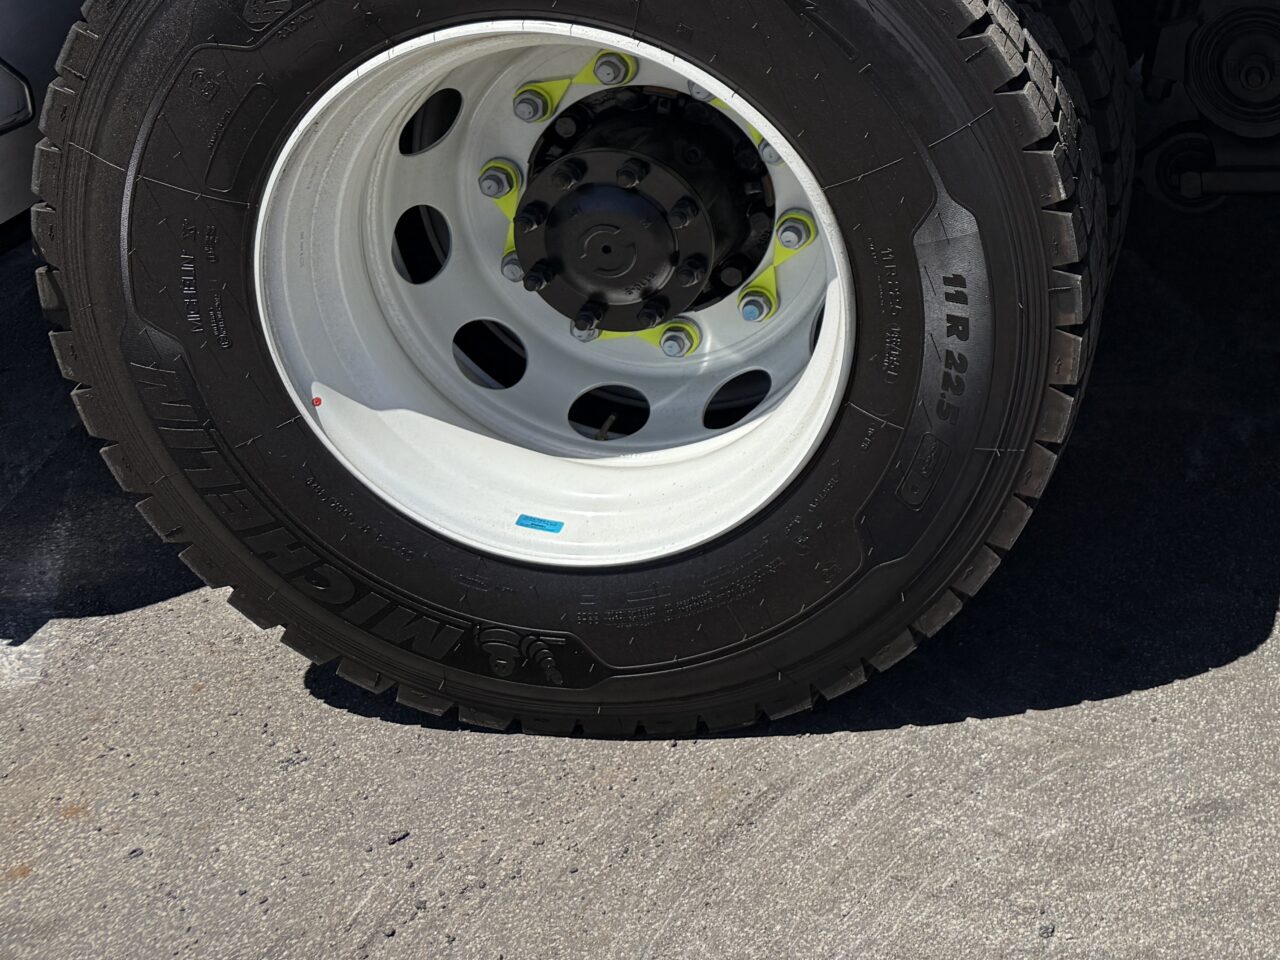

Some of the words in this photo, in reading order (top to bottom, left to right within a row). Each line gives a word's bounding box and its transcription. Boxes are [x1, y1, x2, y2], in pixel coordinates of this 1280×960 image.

[179, 253, 205, 334] MICHELIN
[941, 272, 968, 304] 11
[943, 315, 969, 341] R
[936, 353, 968, 424] 22.5
[131, 362, 468, 661] MICHELIN
